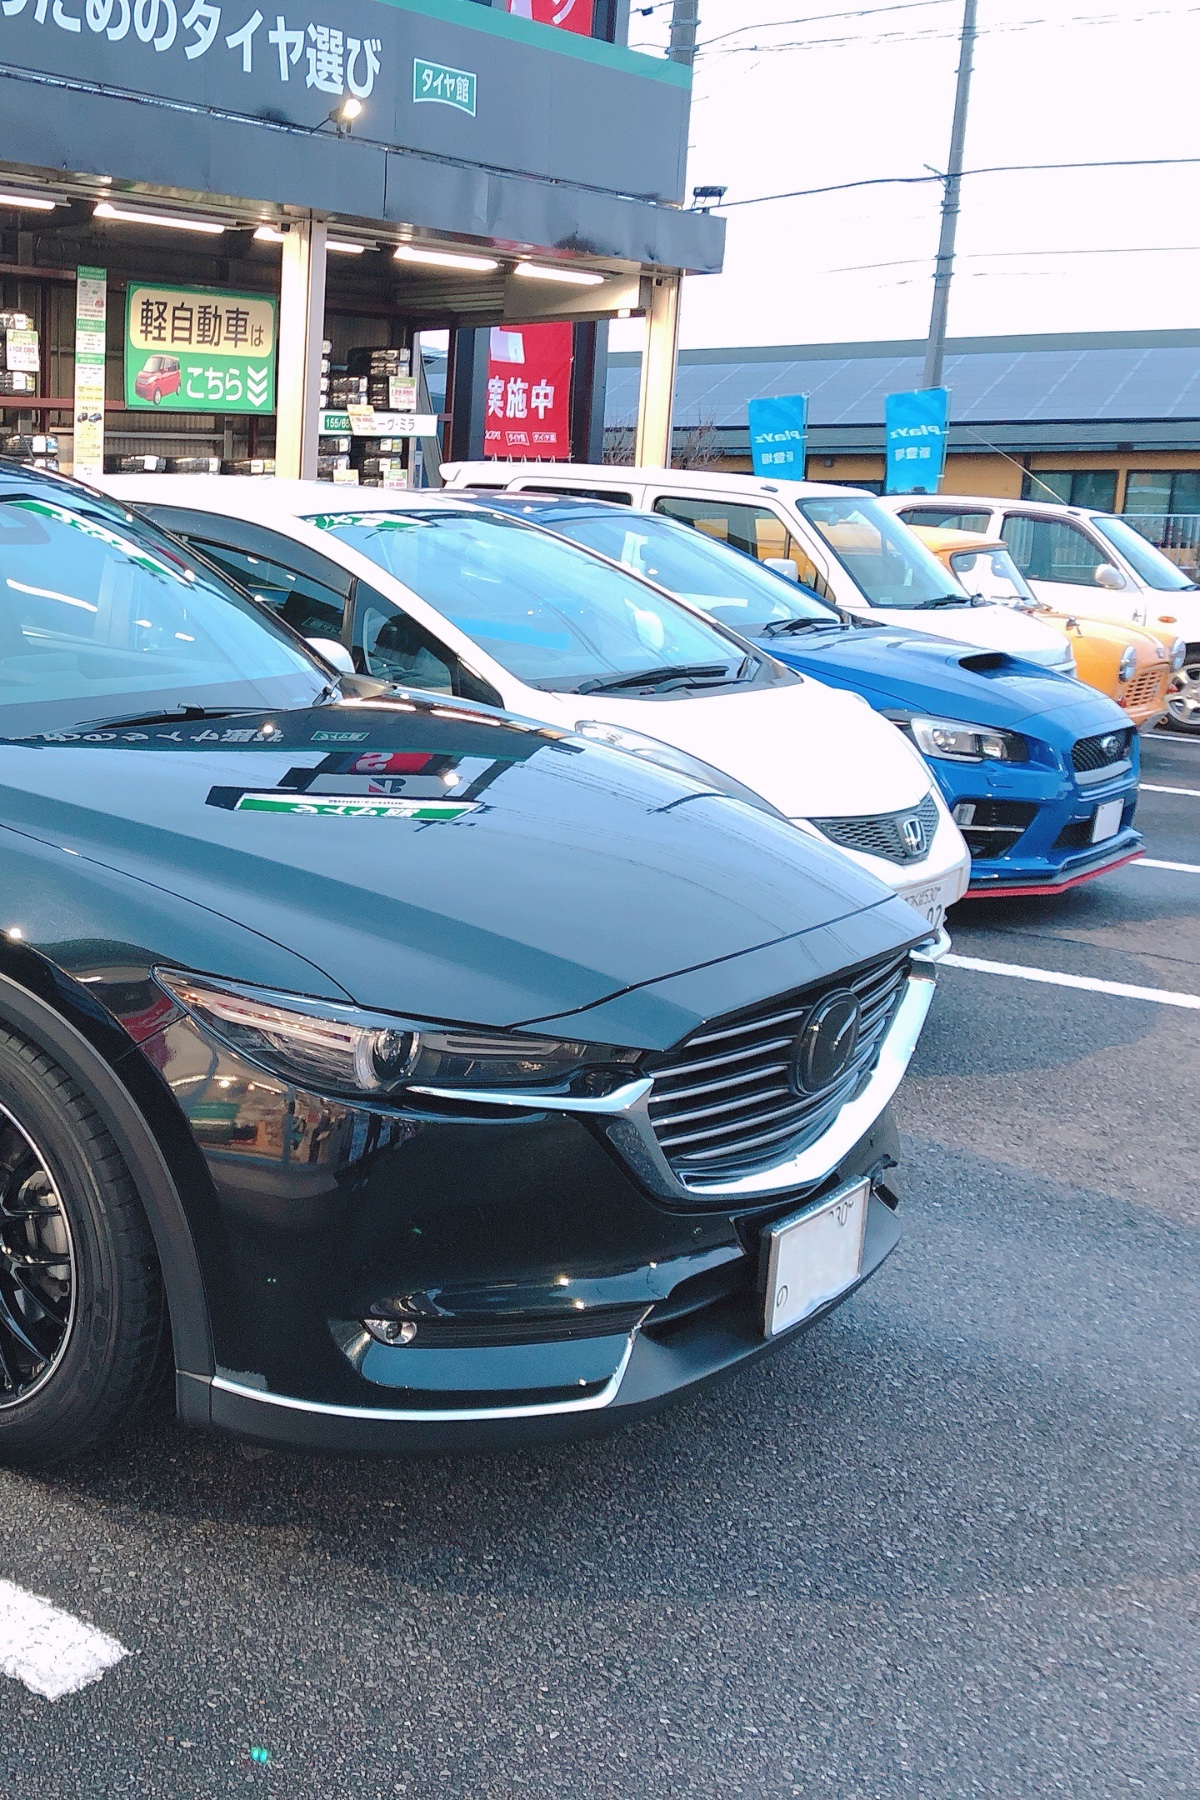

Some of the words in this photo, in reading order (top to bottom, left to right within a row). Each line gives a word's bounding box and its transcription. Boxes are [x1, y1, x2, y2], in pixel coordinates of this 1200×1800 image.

[421, 68, 469, 103] タイヤ館
[140, 298, 265, 348] 軽自動車は
[186, 366, 243, 401] こちら
[487, 374, 555, 420] 実施中
